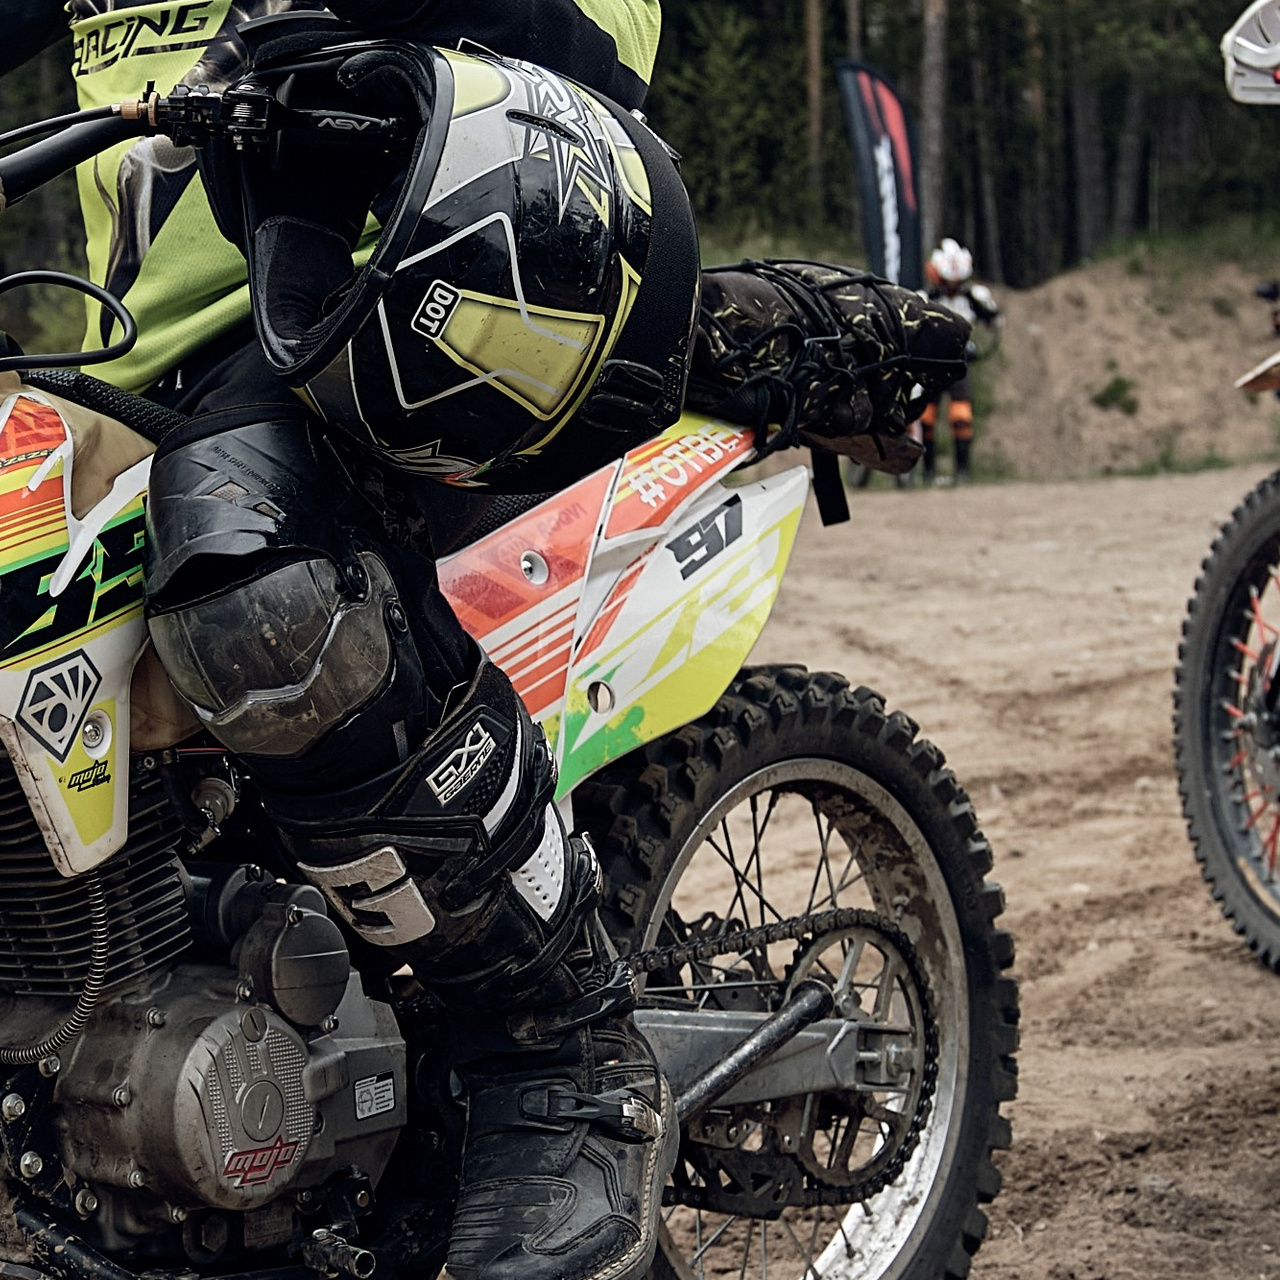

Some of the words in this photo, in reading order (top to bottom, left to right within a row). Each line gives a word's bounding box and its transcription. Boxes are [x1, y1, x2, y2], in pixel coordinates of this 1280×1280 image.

[318, 117, 371, 131] ASV
[419, 287, 455, 334] DOT
[664, 493, 743, 581] 97
[226, 1139, 297, 1182] mojo
